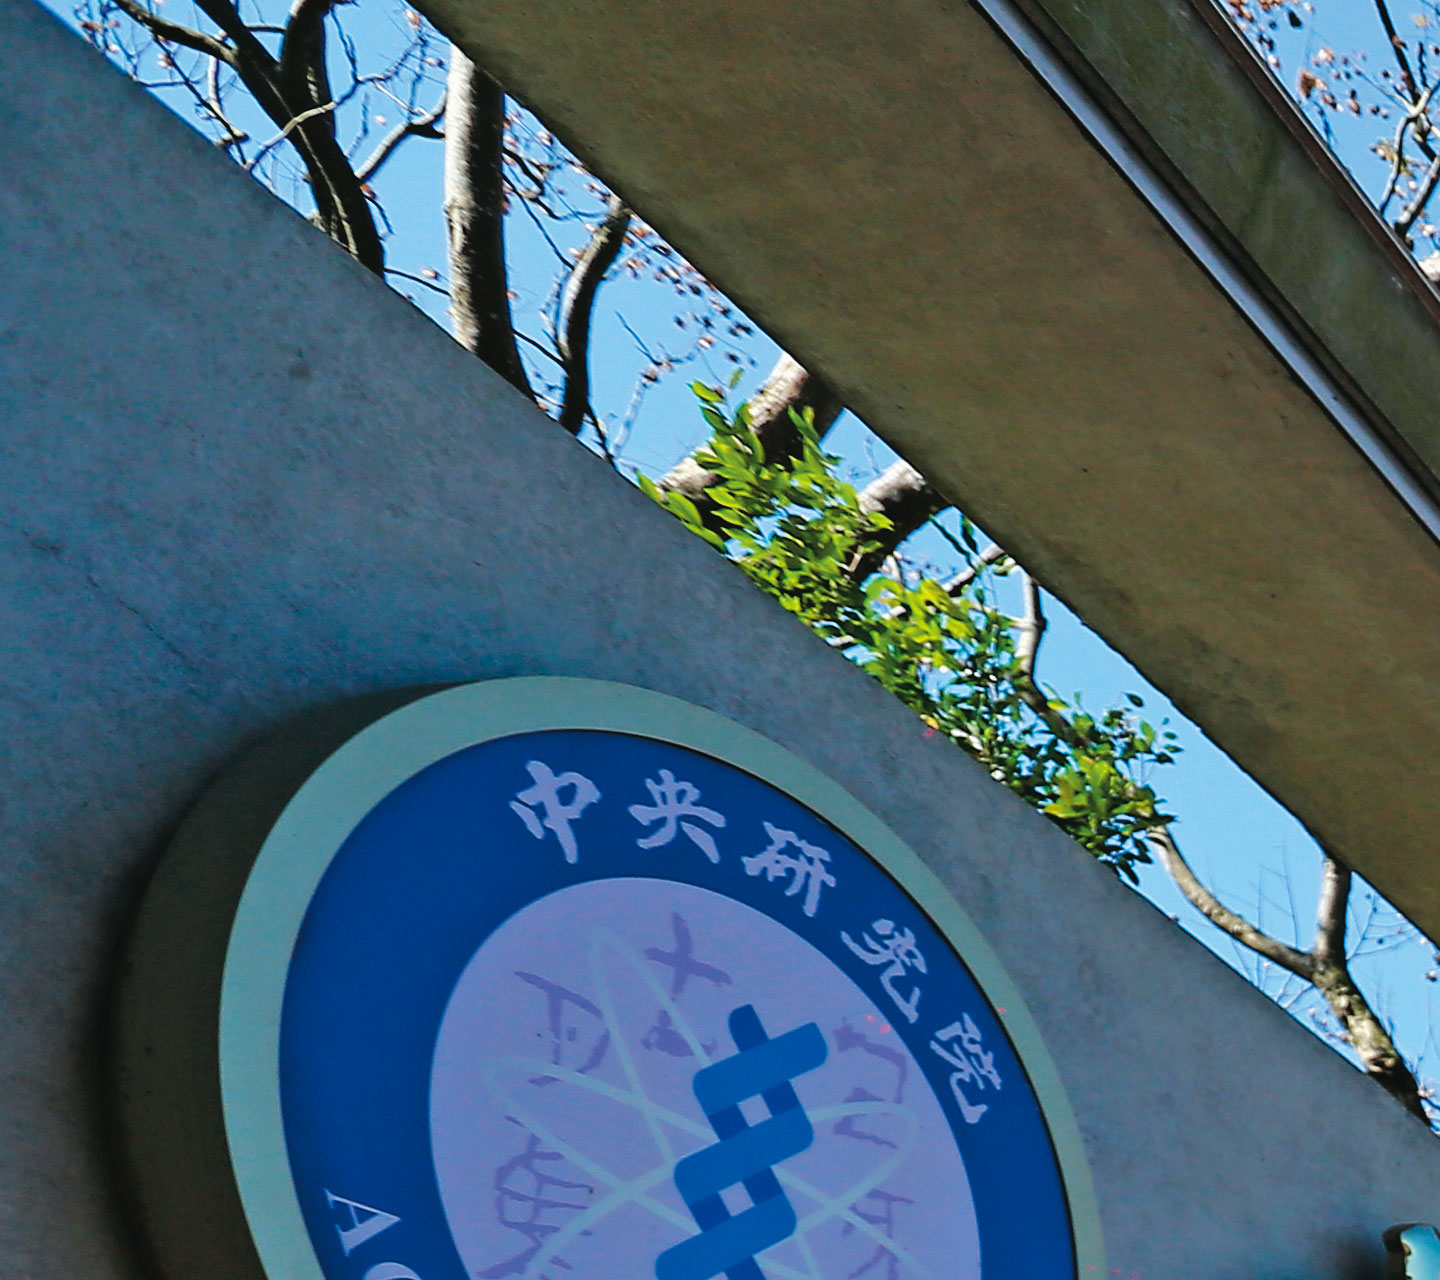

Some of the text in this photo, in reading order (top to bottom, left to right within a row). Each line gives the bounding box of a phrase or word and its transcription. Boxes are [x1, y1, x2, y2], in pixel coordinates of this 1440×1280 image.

[510, 760, 1000, 1126] 中央研究院
